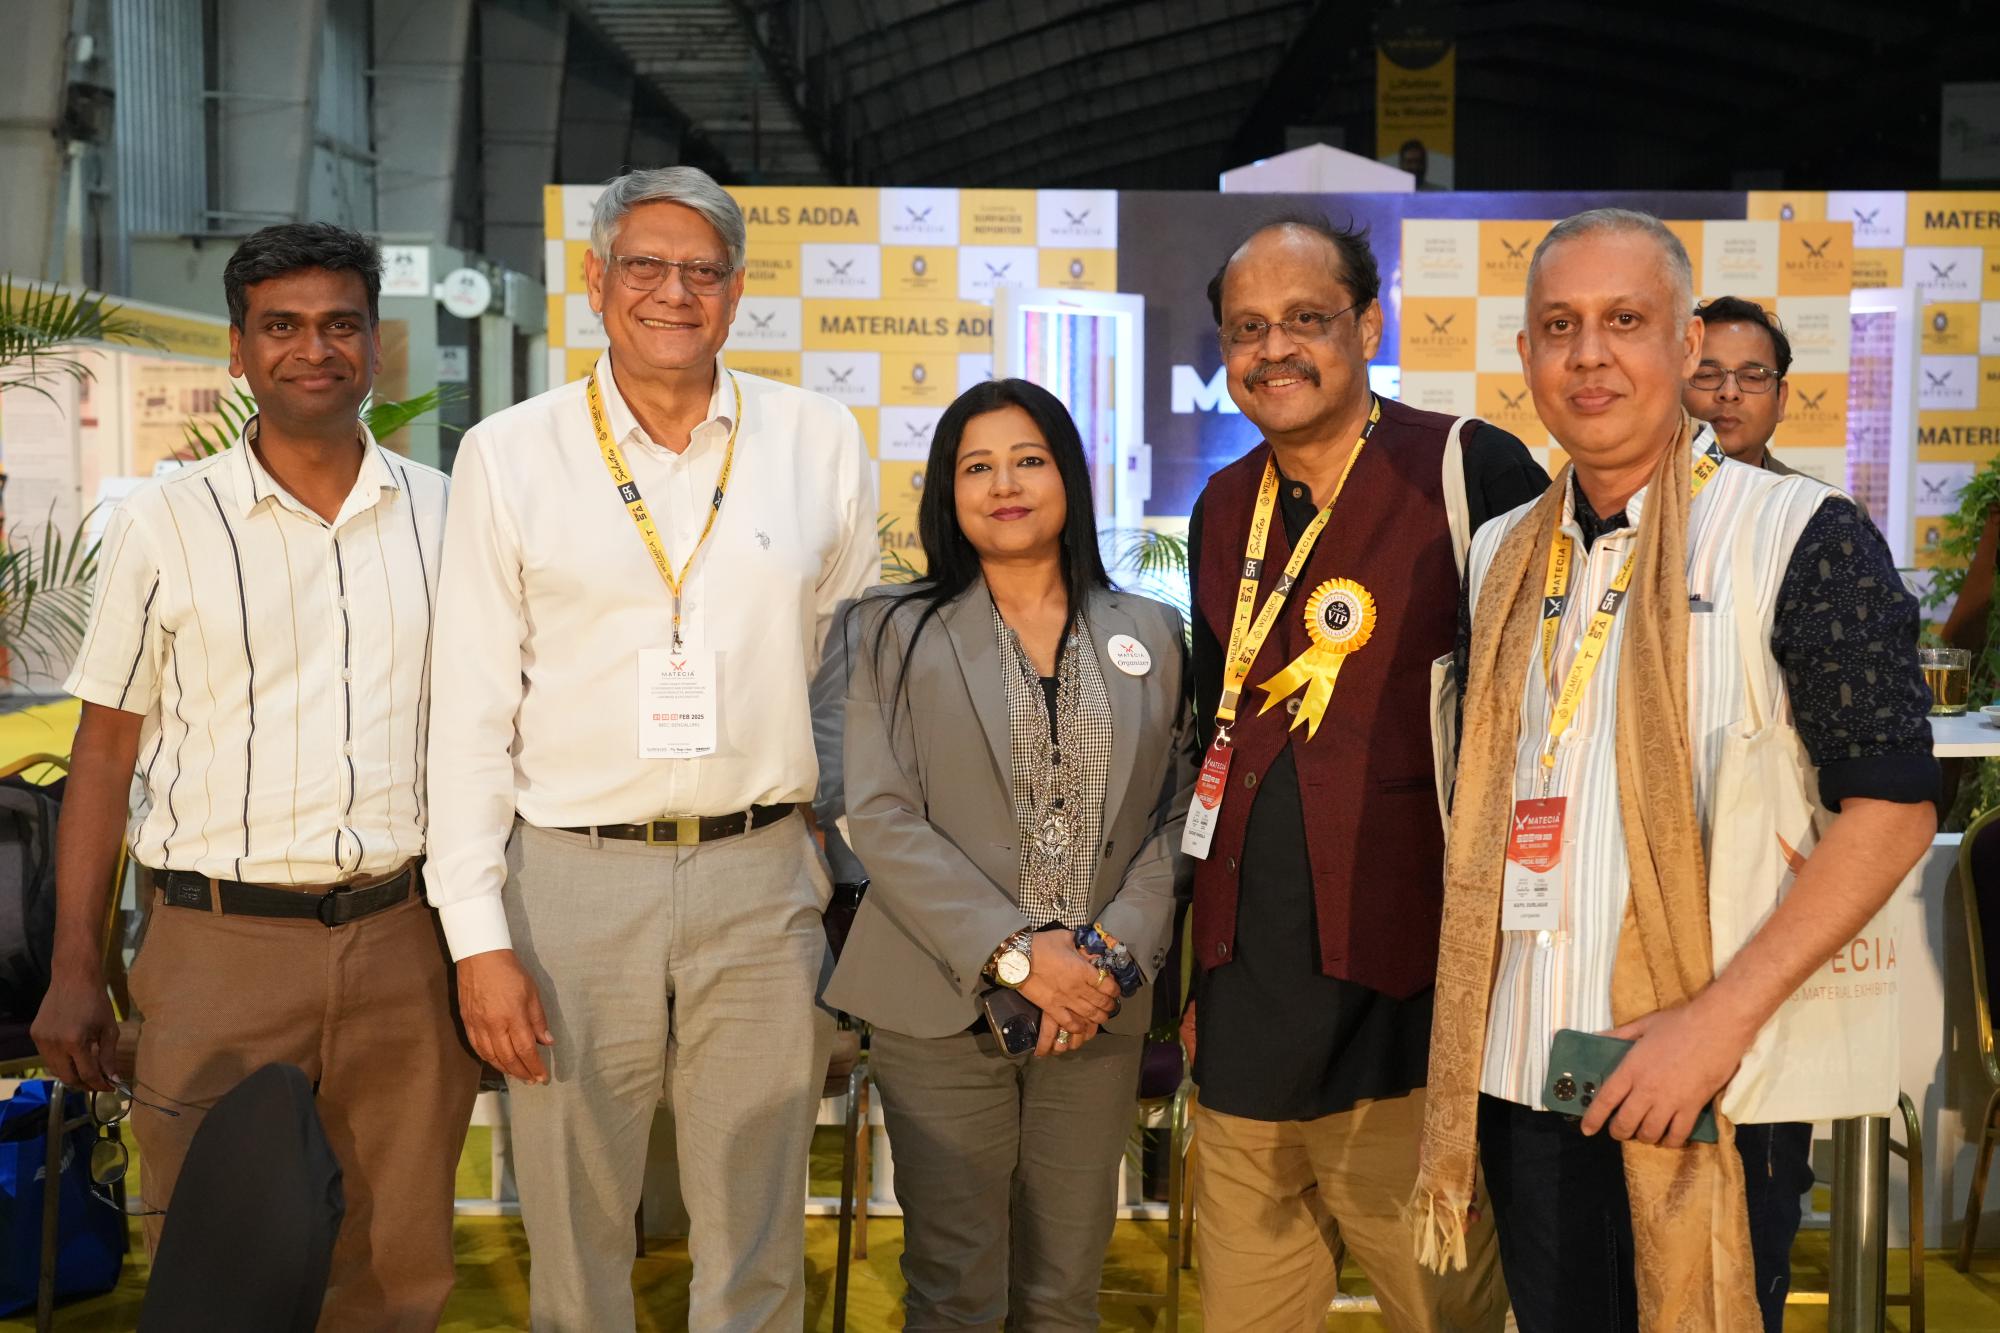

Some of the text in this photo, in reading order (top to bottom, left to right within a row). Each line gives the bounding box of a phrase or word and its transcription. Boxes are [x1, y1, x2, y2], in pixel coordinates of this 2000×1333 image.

[742, 206, 859, 226] ALS ADDA
[1786, 261, 1844, 270] MATECIA
[820, 316, 992, 337] MATERIALS AD
[1409, 336, 1468, 346] MATECIA
[622, 485, 636, 501] SR
[1289, 531, 1315, 575] MATECIA
[1245, 560, 1257, 577] SR
[1552, 547, 1566, 595] MATECIA
[1602, 592, 1618, 611] SR
[1328, 609, 1348, 625] VIP
[1527, 815, 1560, 825] MATECIA
[1832, 937, 1897, 974] ECIA
[1802, 985, 1851, 1001] MATERIAL
[1855, 982, 1898, 998] EXHIBITIO
